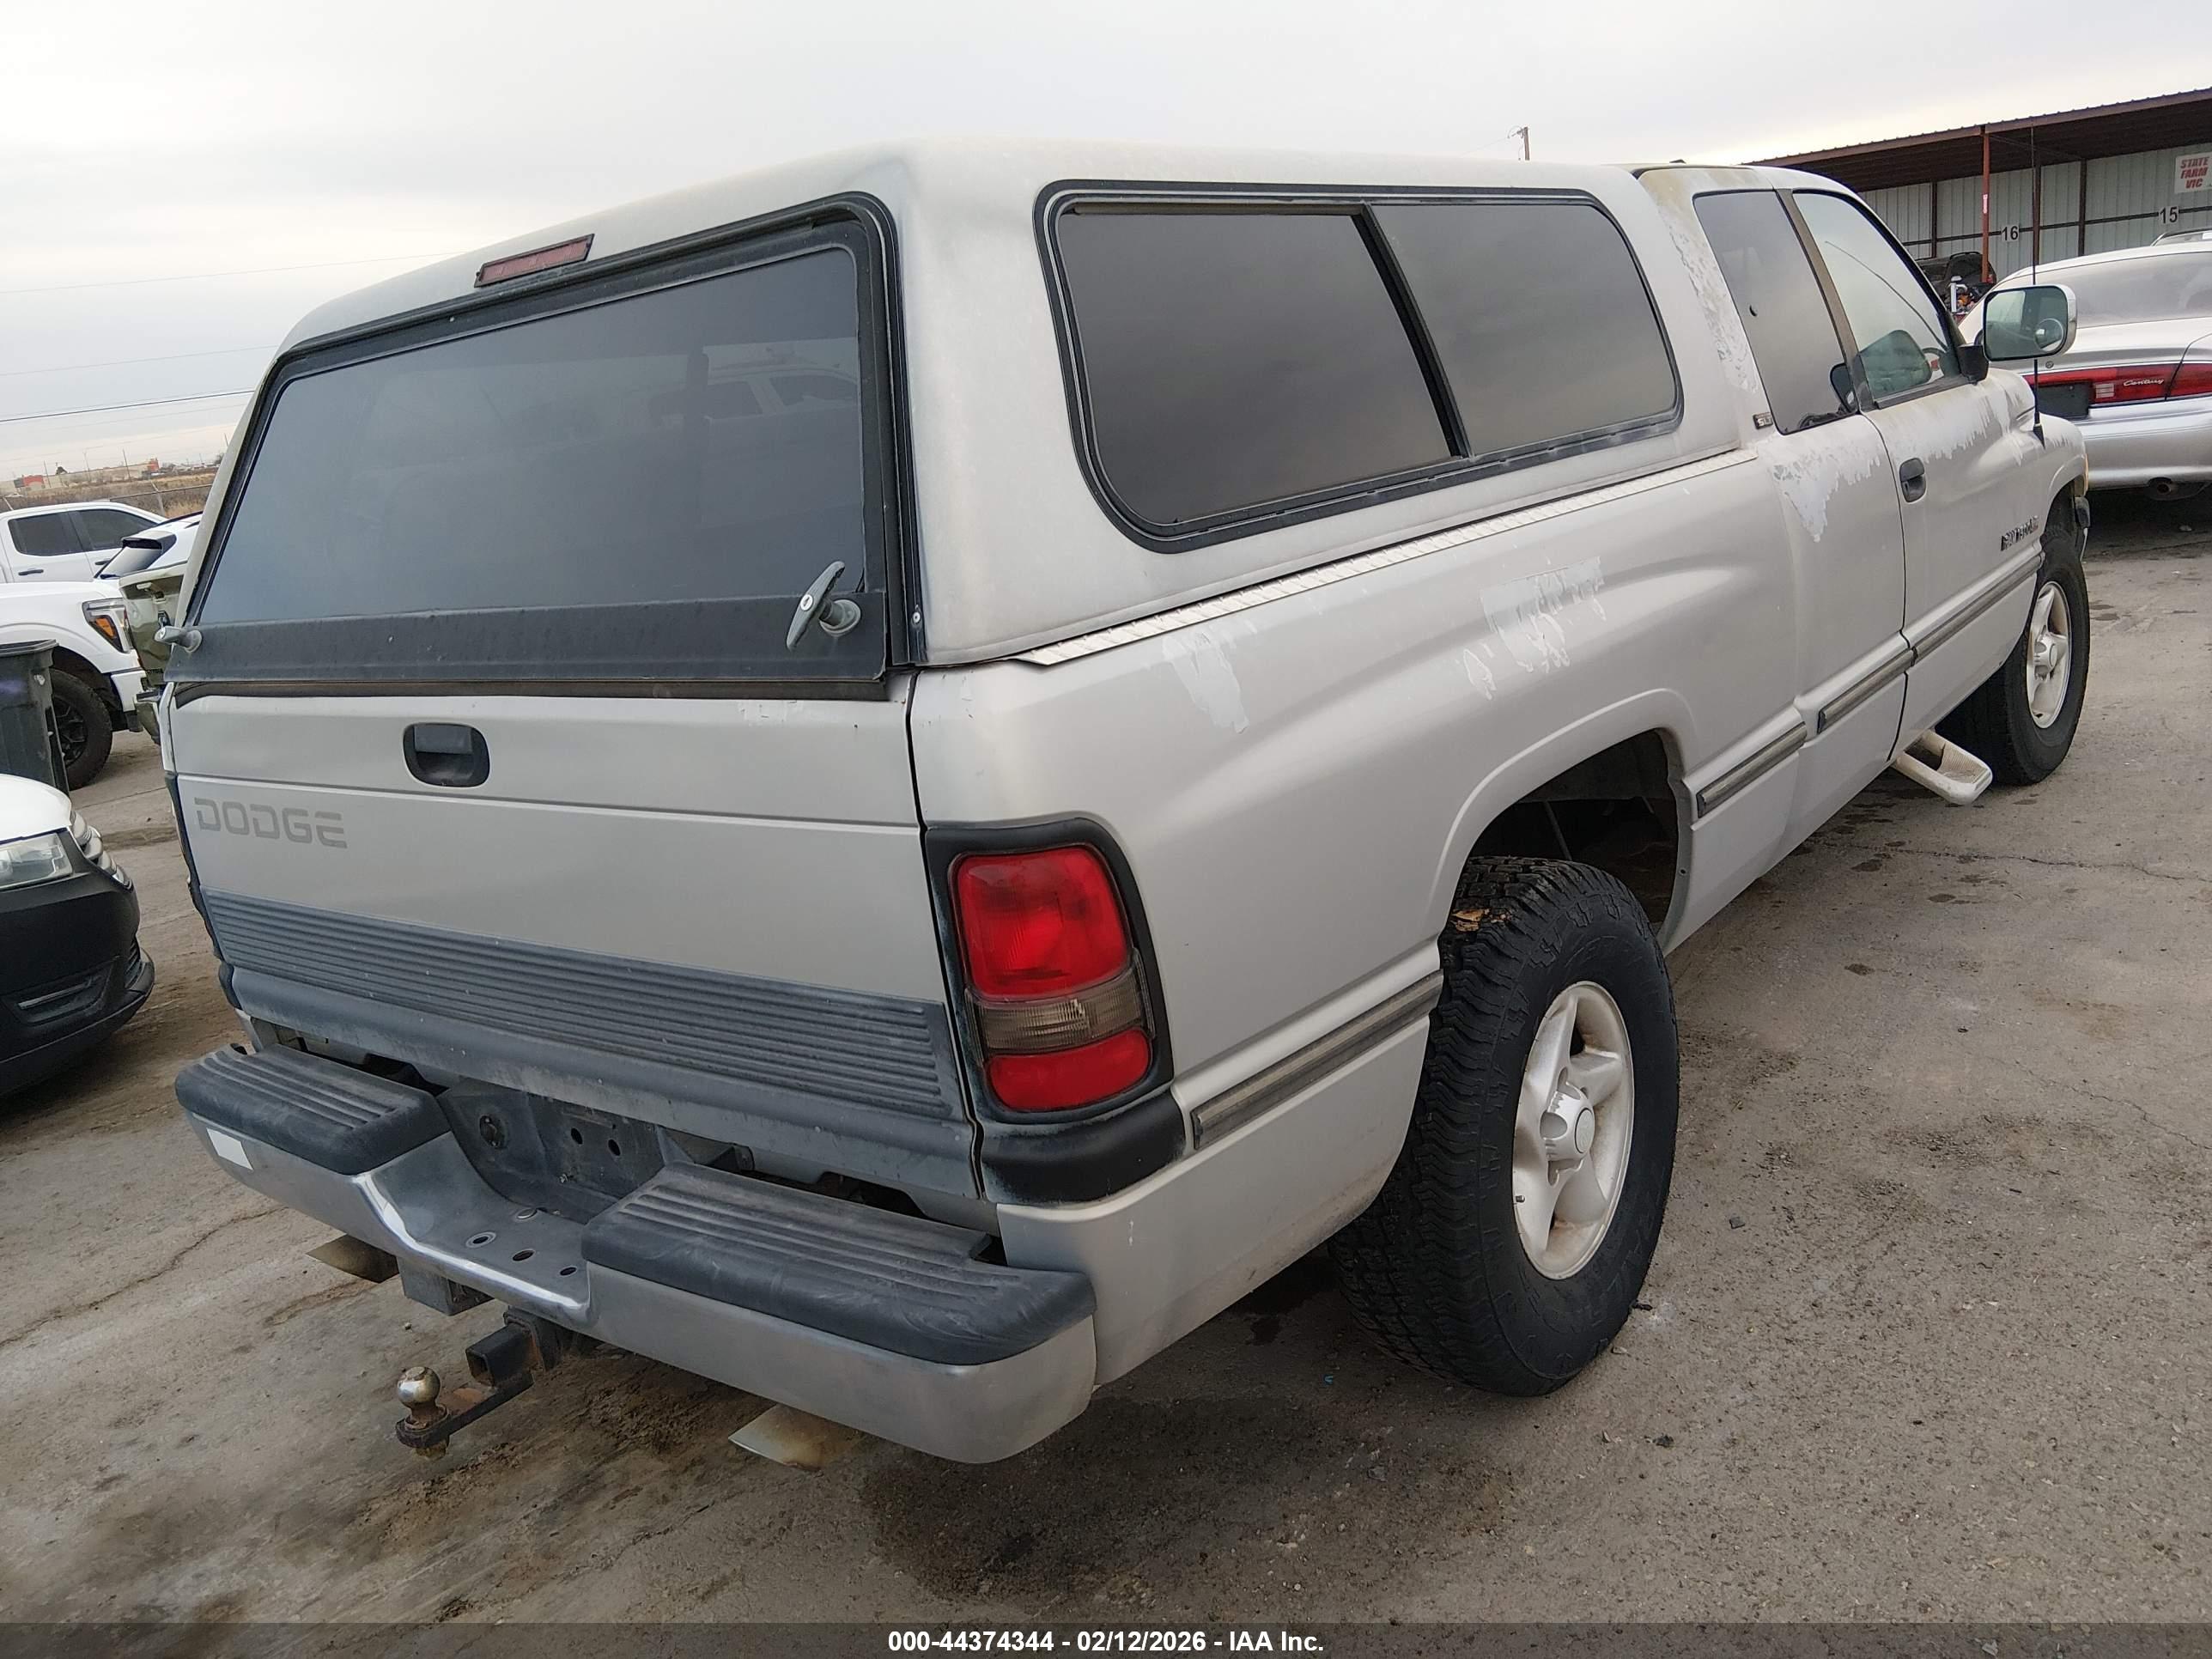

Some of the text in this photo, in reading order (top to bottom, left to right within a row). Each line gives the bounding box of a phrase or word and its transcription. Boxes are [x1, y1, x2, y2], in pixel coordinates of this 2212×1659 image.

[2180, 157, 2209, 169] STATE
[2180, 167, 2208, 179] FARM
[2185, 179, 2203, 189] VIC
[2160, 206, 2178, 223] 15
[2002, 225, 2019, 241] 16
[2123, 378, 2165, 386] Century
[194, 797, 347, 848] DODGE
